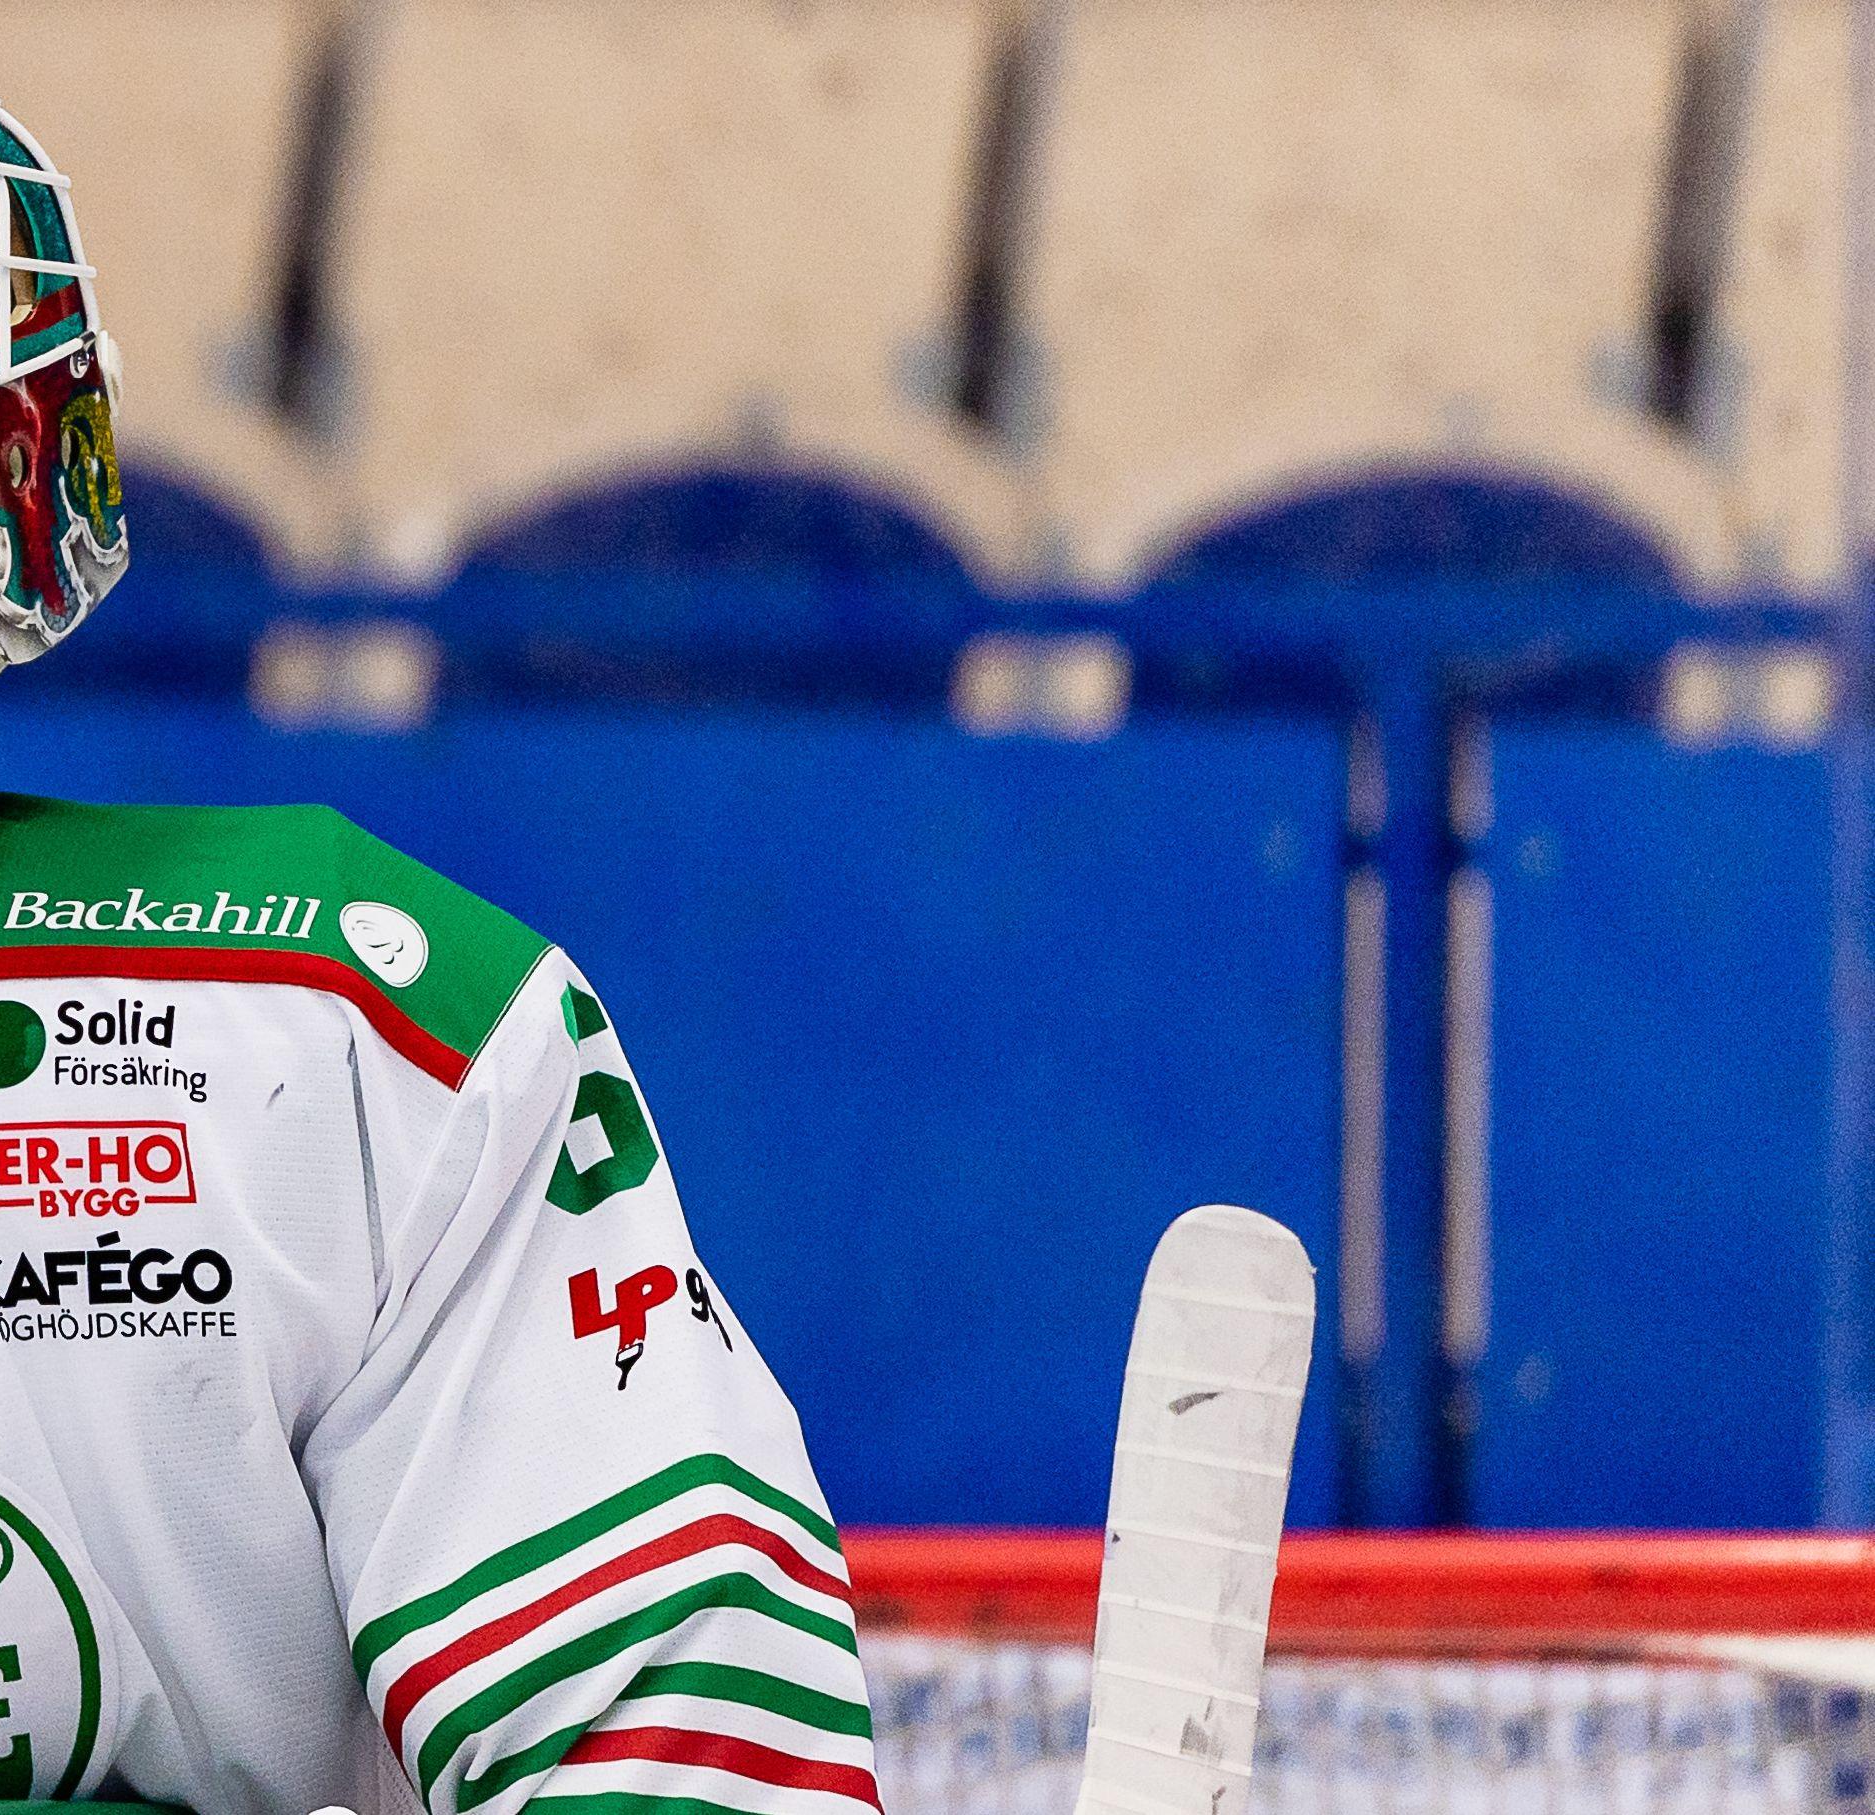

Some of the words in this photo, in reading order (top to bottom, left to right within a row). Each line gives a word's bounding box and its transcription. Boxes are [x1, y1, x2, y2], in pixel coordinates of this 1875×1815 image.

[2, 888, 322, 939] Backahill
[54, 998, 176, 1049] Solid
[54, 1055, 208, 1104] Försäkring
[38, 1187, 141, 1218] BYGG
[568, 1264, 678, 1351] LP
